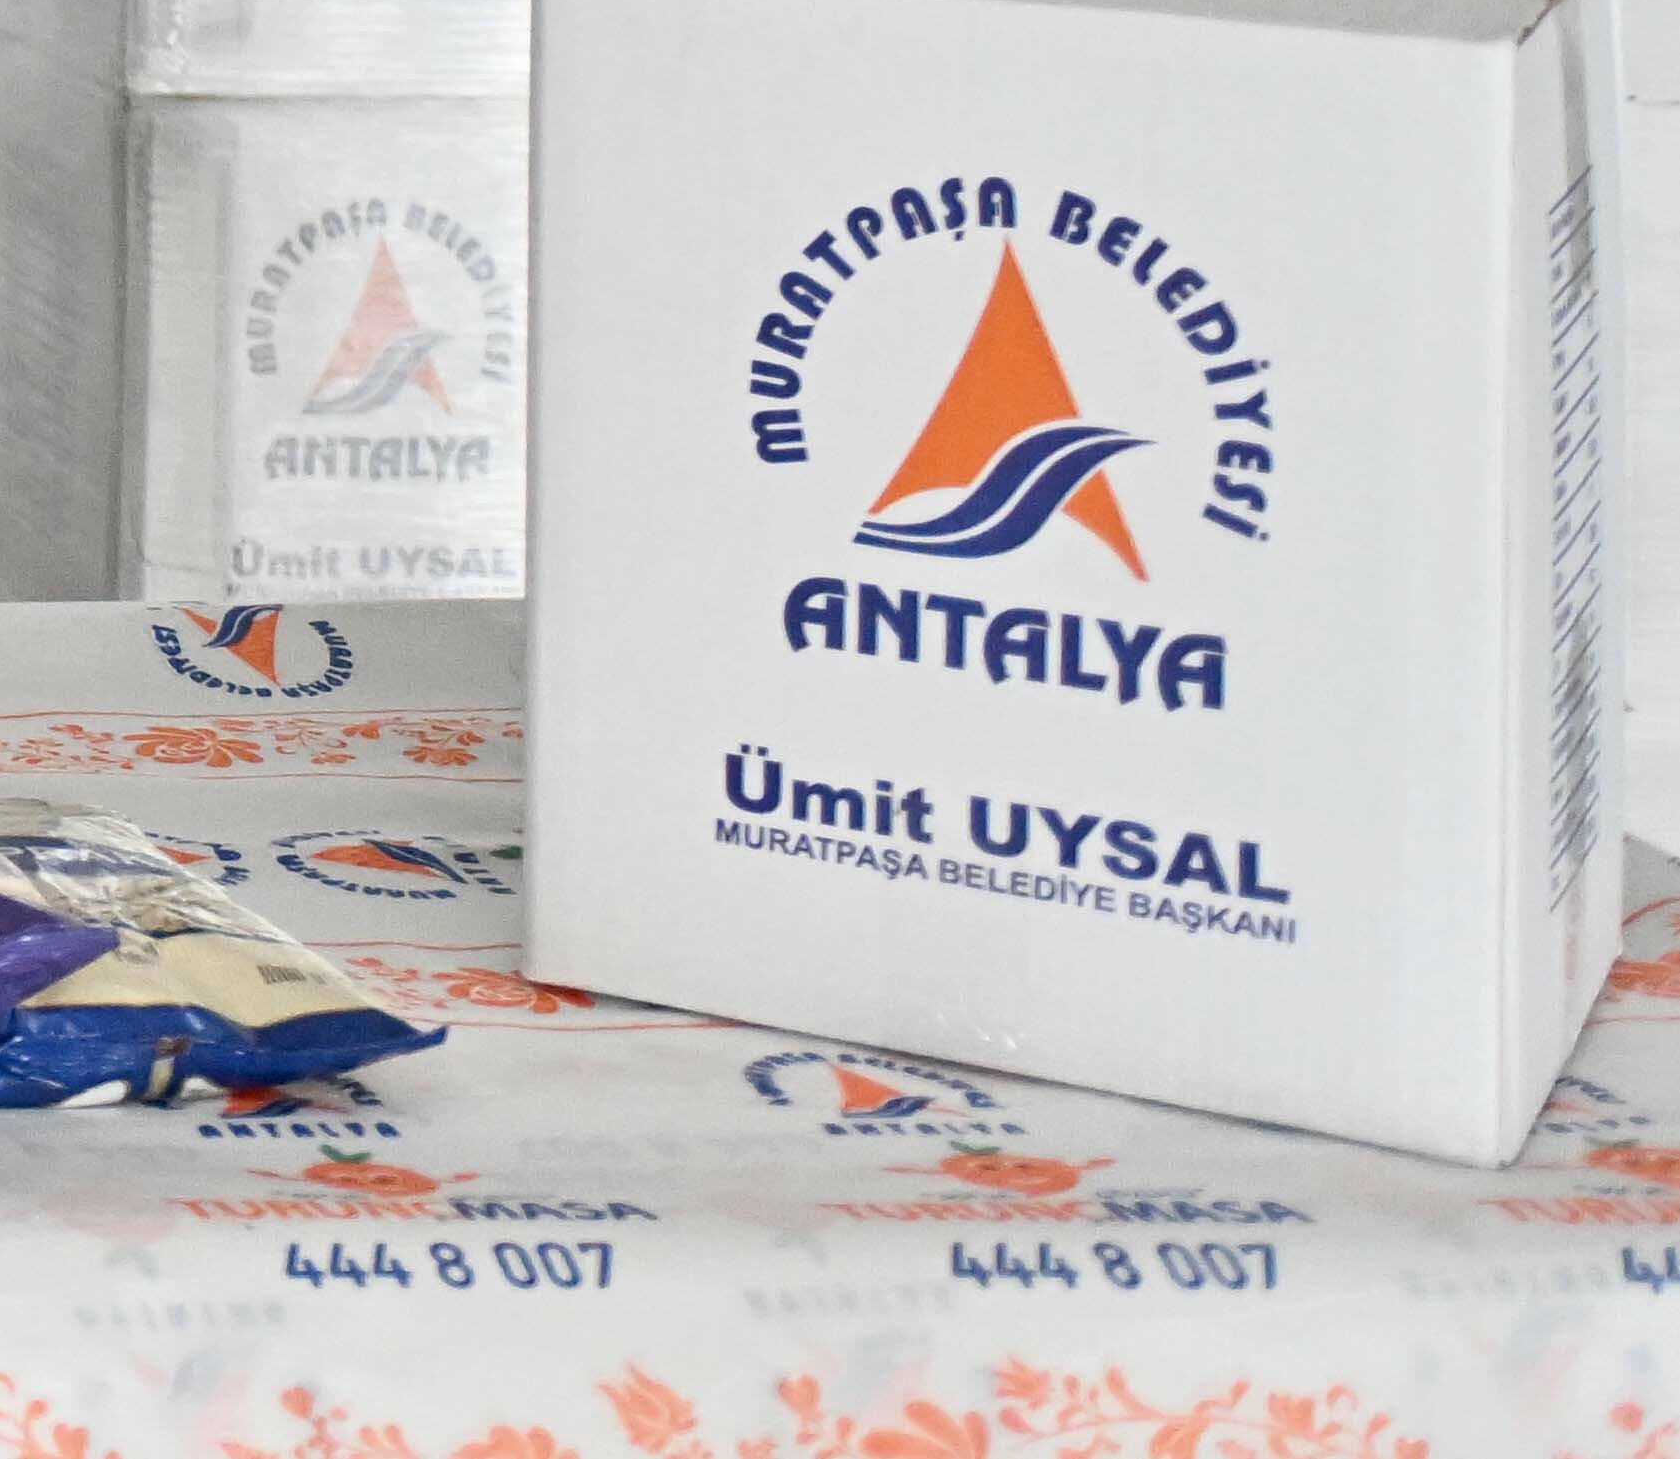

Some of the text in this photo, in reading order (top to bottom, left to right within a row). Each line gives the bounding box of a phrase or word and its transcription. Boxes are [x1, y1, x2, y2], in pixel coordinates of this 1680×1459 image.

[749, 176, 1019, 466] MURATPAŞA
[1047, 190, 1277, 544] BELEDİYESİ
[782, 577, 1228, 712] ANTALYA
[713, 818, 1299, 945] MURATPAŞA BELEDİYE BAŞKANI
[725, 744, 1292, 906] Ümit UYSAL
[283, 1240, 616, 1290] 444 8 007
[949, 1241, 1279, 1290] 444 8 007
